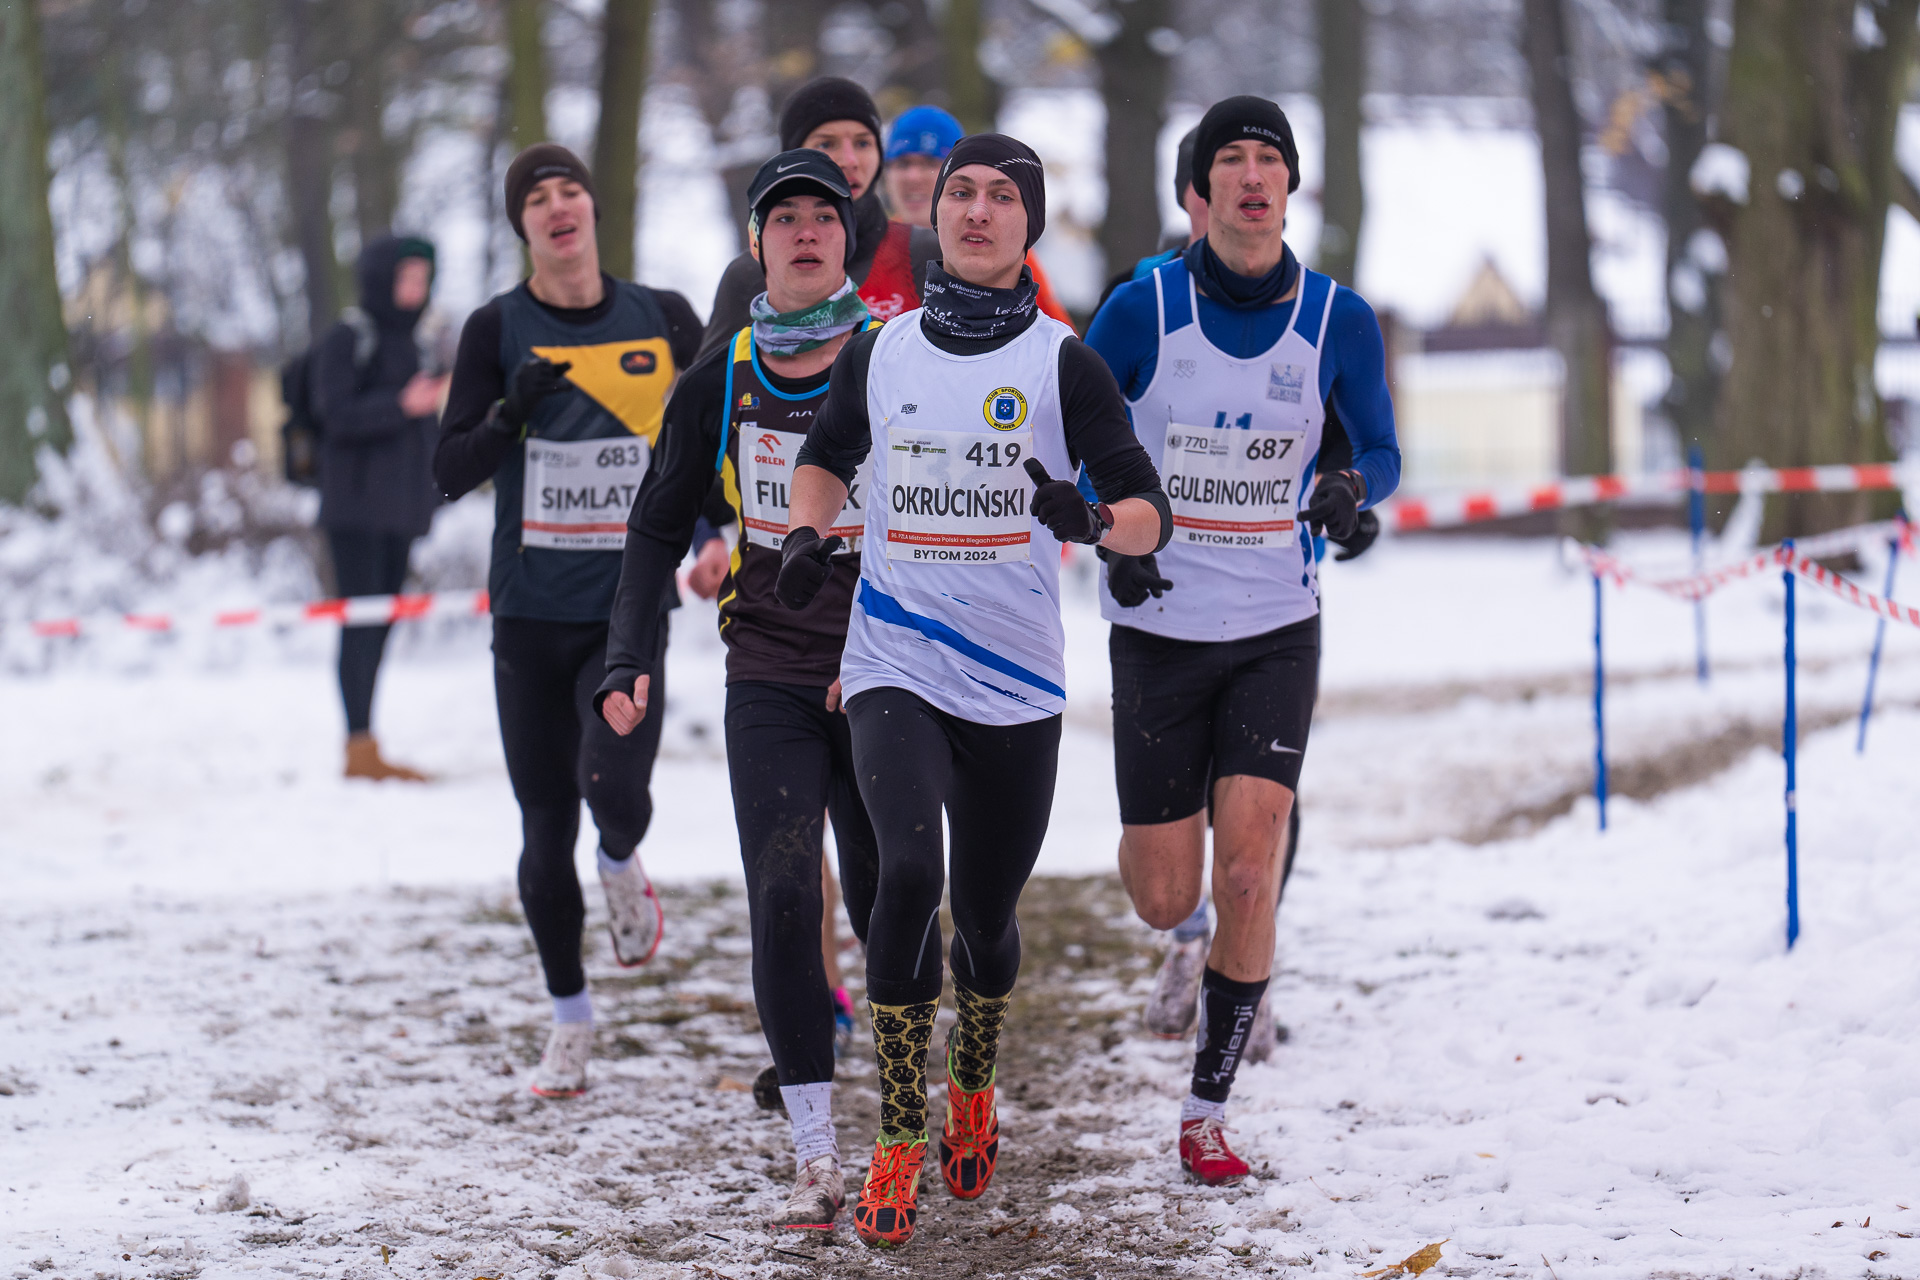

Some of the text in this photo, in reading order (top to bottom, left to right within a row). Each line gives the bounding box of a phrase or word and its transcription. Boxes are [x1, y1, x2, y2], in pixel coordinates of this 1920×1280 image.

[1185, 435, 1208, 449] 770
[1246, 438, 1294, 460] 687
[596, 445, 640, 468] 683
[754, 454, 785, 467] ORLEN
[965, 442, 1021, 467] 419
[541, 485, 636, 510] SIMLAT
[756, 479, 862, 510] FILK
[892, 483, 1025, 518] OKRUCIŃSKI
[1167, 474, 1292, 506] GULBINOWICZ
[909, 534, 941, 542] Mistrzostwa
[966, 537, 991, 545] Biegach
[1188, 532, 1264, 545] BYTOM 2024
[914, 549, 997, 561] BYTOM 2024
